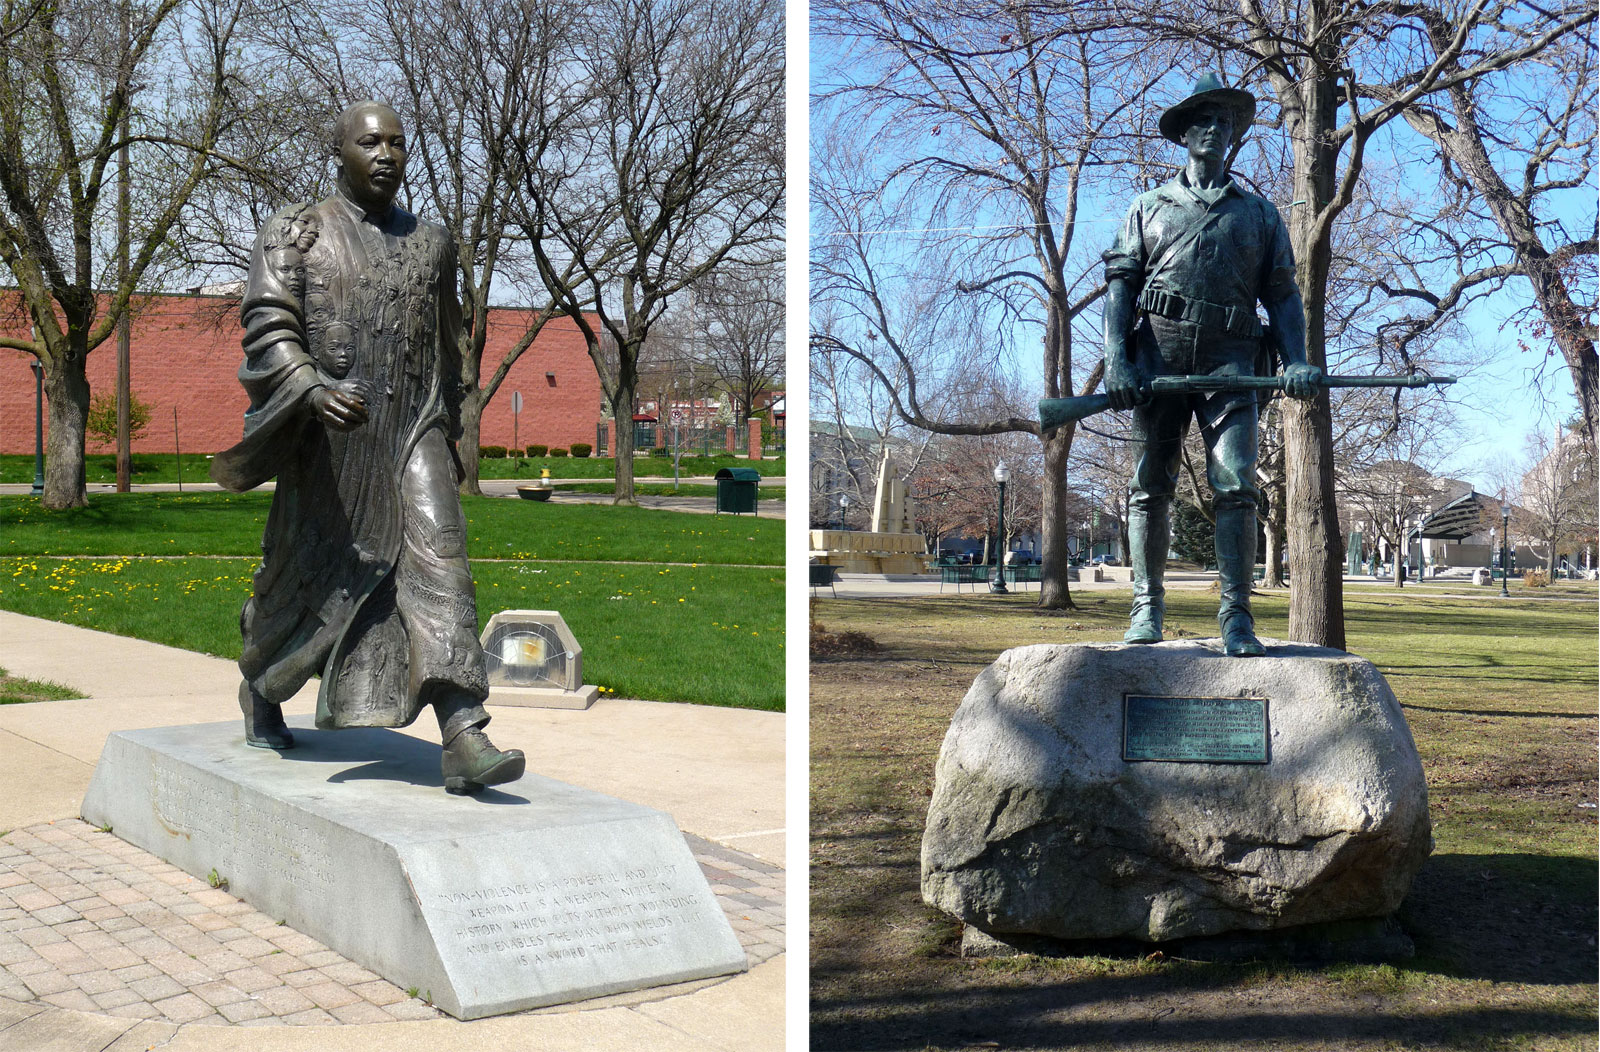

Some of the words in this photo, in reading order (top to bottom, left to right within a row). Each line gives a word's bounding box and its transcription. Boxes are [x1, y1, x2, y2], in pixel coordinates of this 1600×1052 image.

[535, 881, 546, 893] IS
[552, 880, 560, 890] A
[563, 872, 620, 888] POWERFUL
[625, 869, 647, 881] AND
[553, 897, 560, 906] A
[564, 890, 610, 906] WEAPON
[659, 881, 671, 892] IN
[455, 923, 502, 940] HISTORY
[512, 917, 547, 931] WHICH
[585, 904, 632, 920] WITHOUT
[466, 943, 490, 957] AND
[495, 935, 545, 952] ENABLES
[548, 931, 572, 943] THE
[575, 927, 600, 939] MAN
[605, 922, 631, 935] WHO
[634, 915, 673, 931] WIELDS
[516, 955, 528, 967] IS
[535, 954, 544, 965] A
[547, 947, 586, 961] SWORD
[590, 941, 618, 954] THAT
